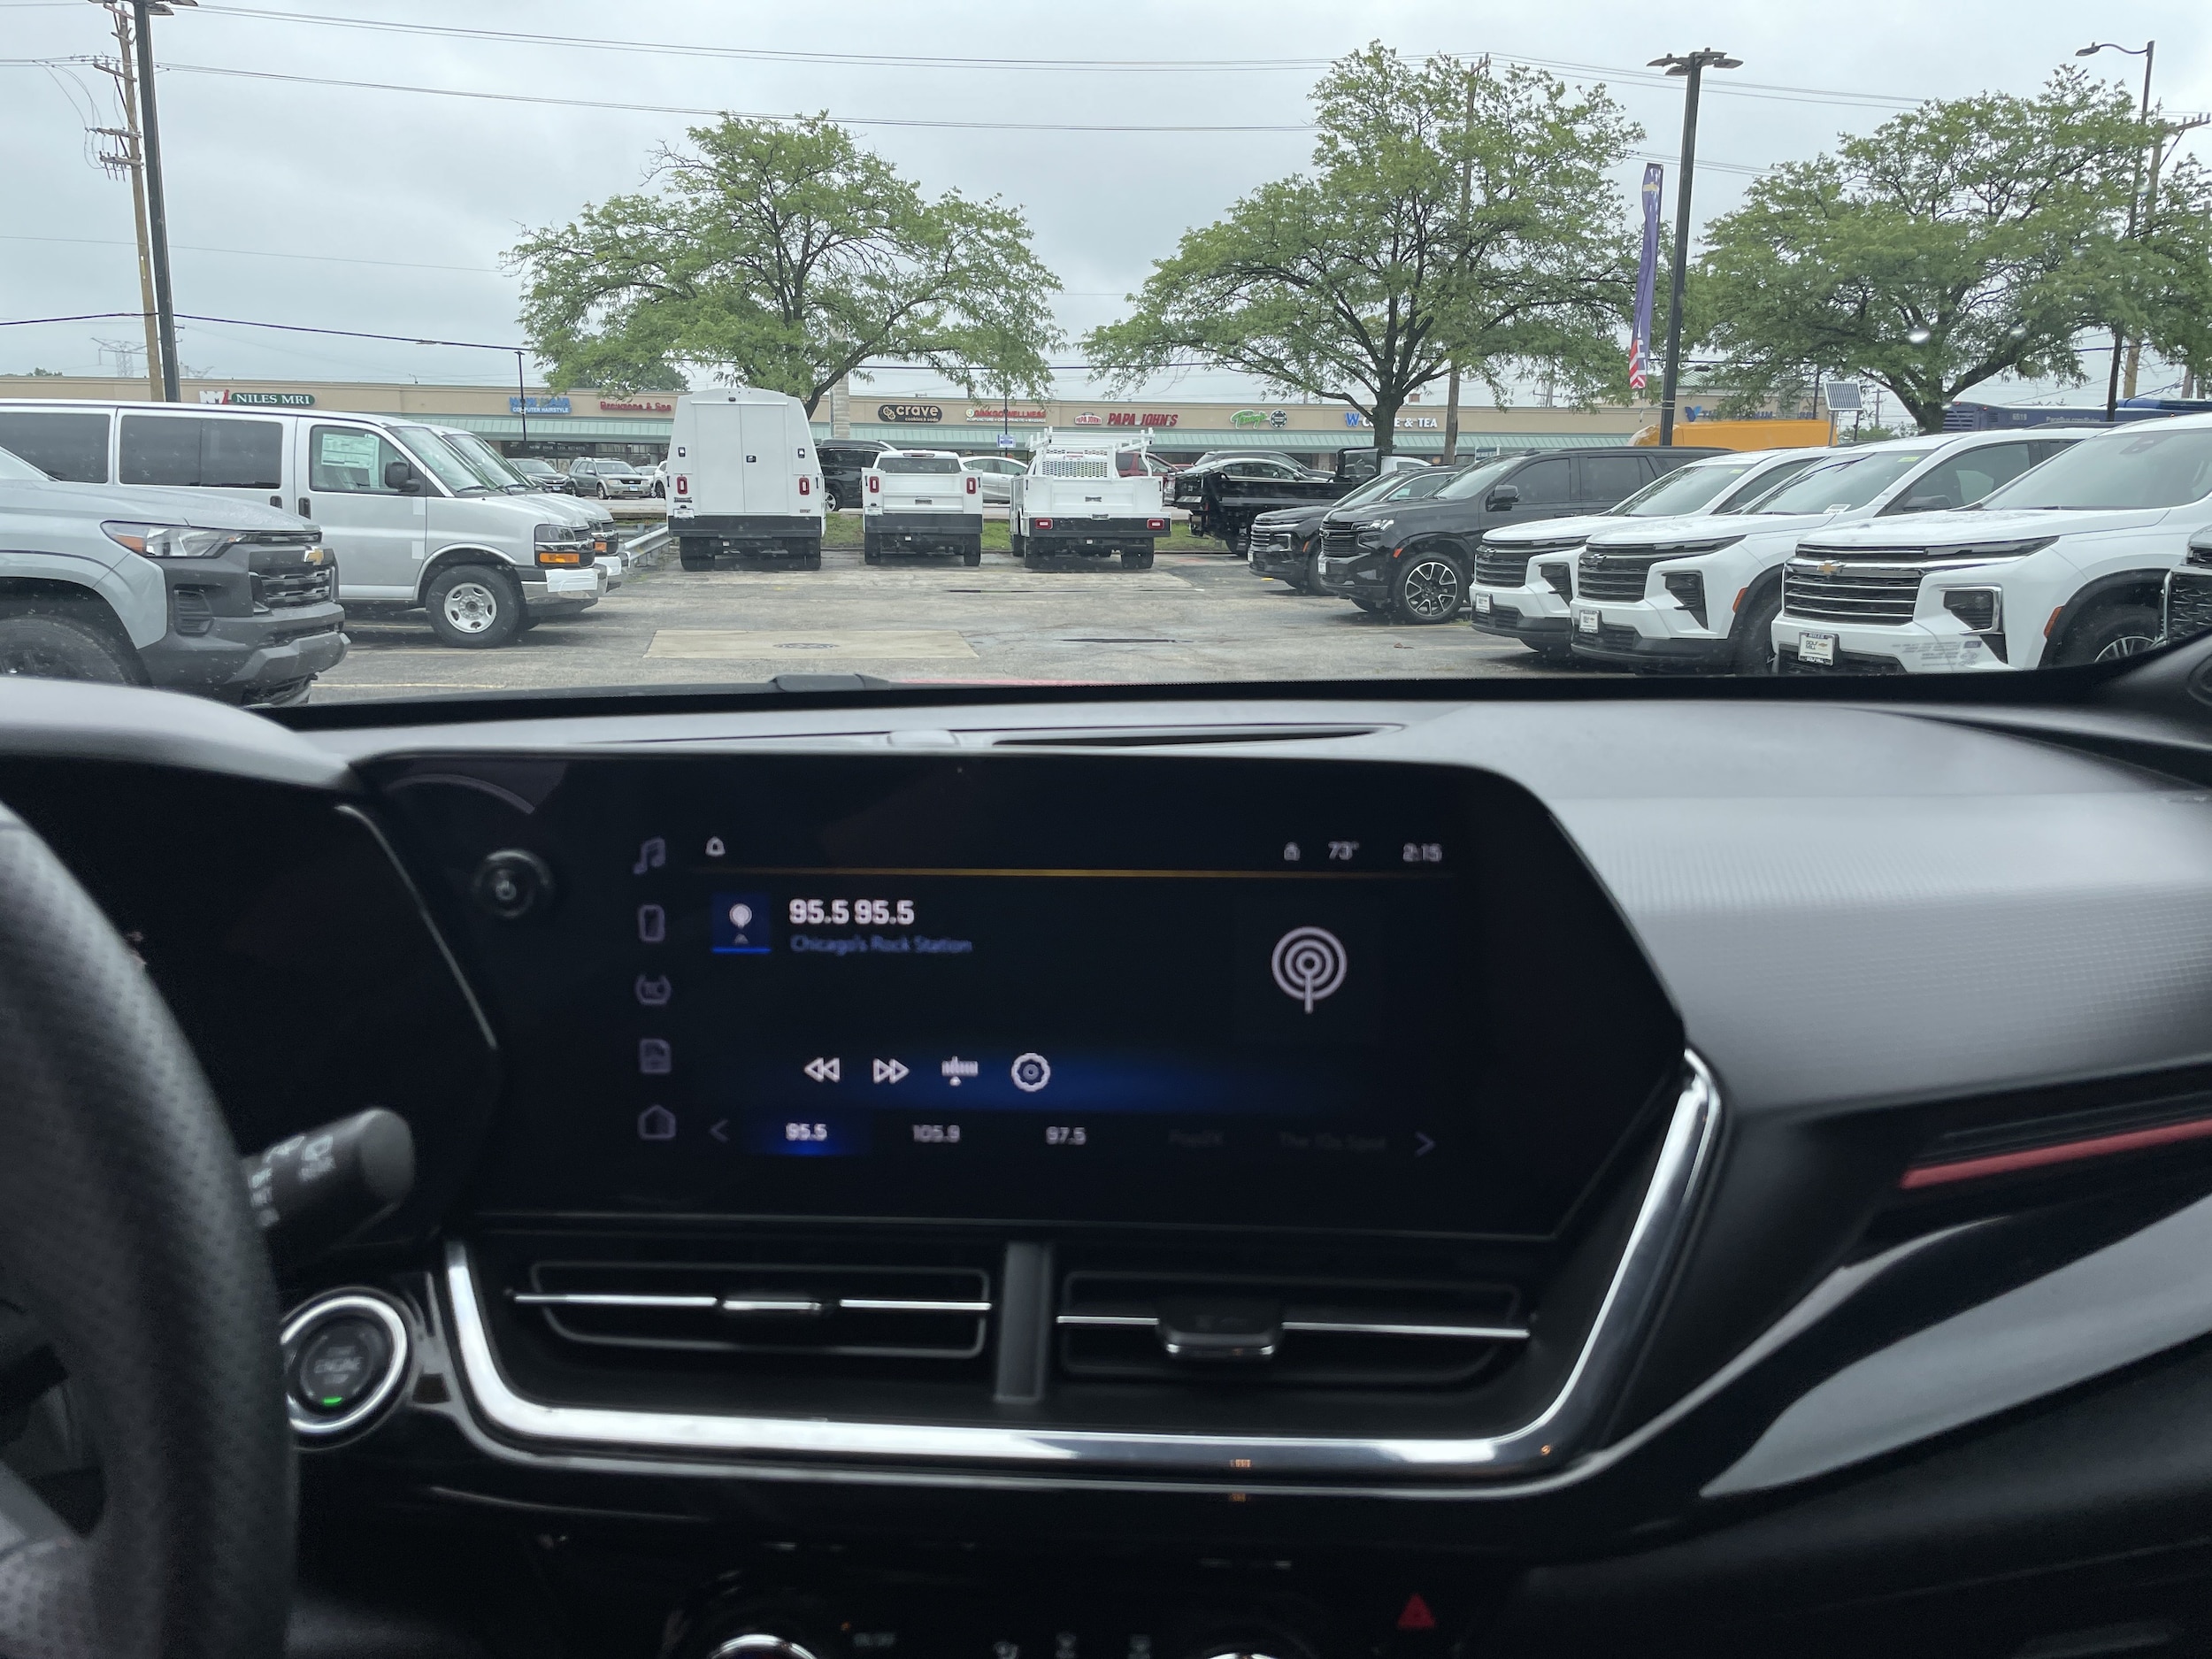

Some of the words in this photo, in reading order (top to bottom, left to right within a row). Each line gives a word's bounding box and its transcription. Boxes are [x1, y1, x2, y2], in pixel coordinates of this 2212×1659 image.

[236, 394, 278, 403] NILES
[281, 395, 311, 404] MRI
[646, 402, 652, 411] &
[655, 402, 672, 411] Spa
[895, 406, 939, 417] crave
[1107, 412, 1136, 426] PAPA
[1140, 413, 1179, 426] JOHN'S
[2012, 412, 2027, 421] 6519
[1404, 418, 1413, 427] &
[1418, 418, 1438, 427] TEA
[788, 898, 850, 925] 95.5
[854, 899, 915, 926] 95.5
[785, 1122, 828, 1141] 95.5
[911, 1124, 961, 1143] 105.9
[1045, 1125, 1087, 1146] 97.5
